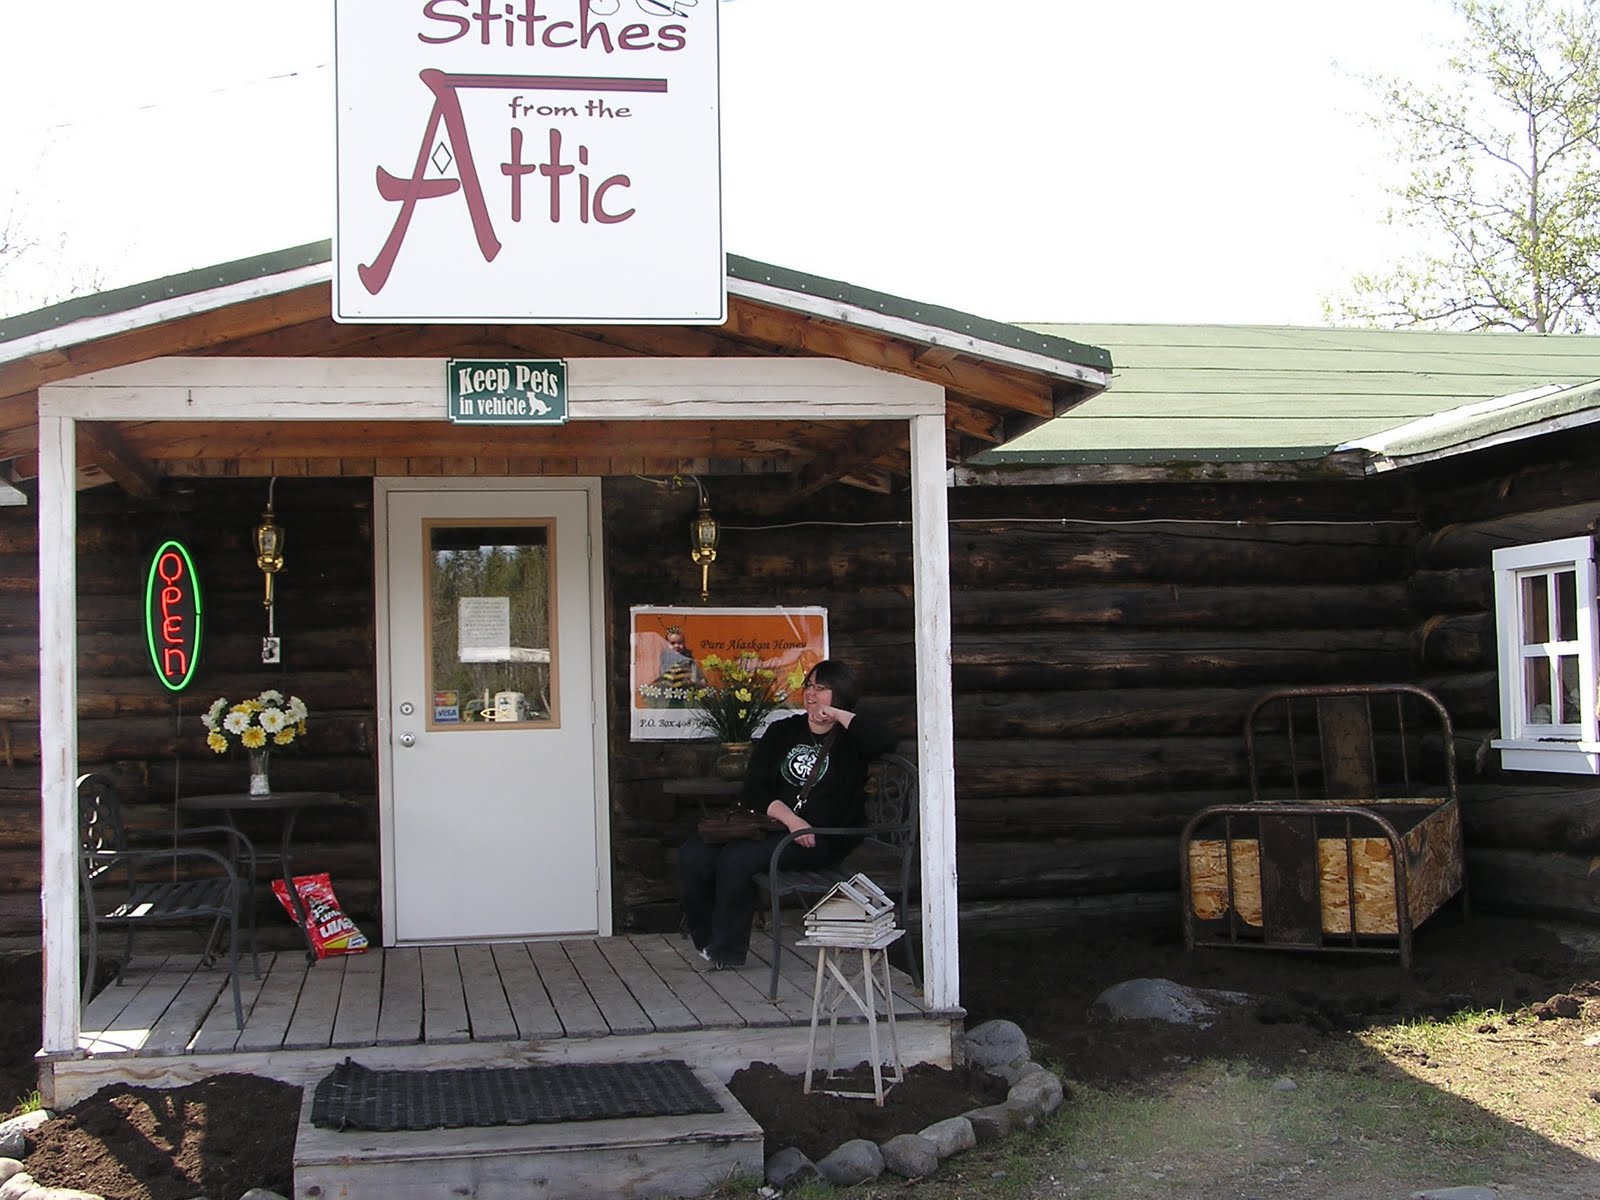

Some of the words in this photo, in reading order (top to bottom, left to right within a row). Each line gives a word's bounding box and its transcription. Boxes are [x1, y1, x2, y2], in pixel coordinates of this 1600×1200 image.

[418, 0, 687, 54] Stitches
[508, 96, 579, 119] from
[585, 99, 632, 119] the
[357, 68, 636, 296] Attic
[458, 367, 510, 396] Keep
[515, 365, 558, 398] Pets
[459, 397, 474, 415] in
[477, 397, 527, 415] vehicle
[700, 639, 725, 650] Pure
[726, 638, 770, 652] Alaskan
[438, 708, 456, 717] VISA
[658, 719, 675, 728] Box
[319, 917, 356, 938] evin
